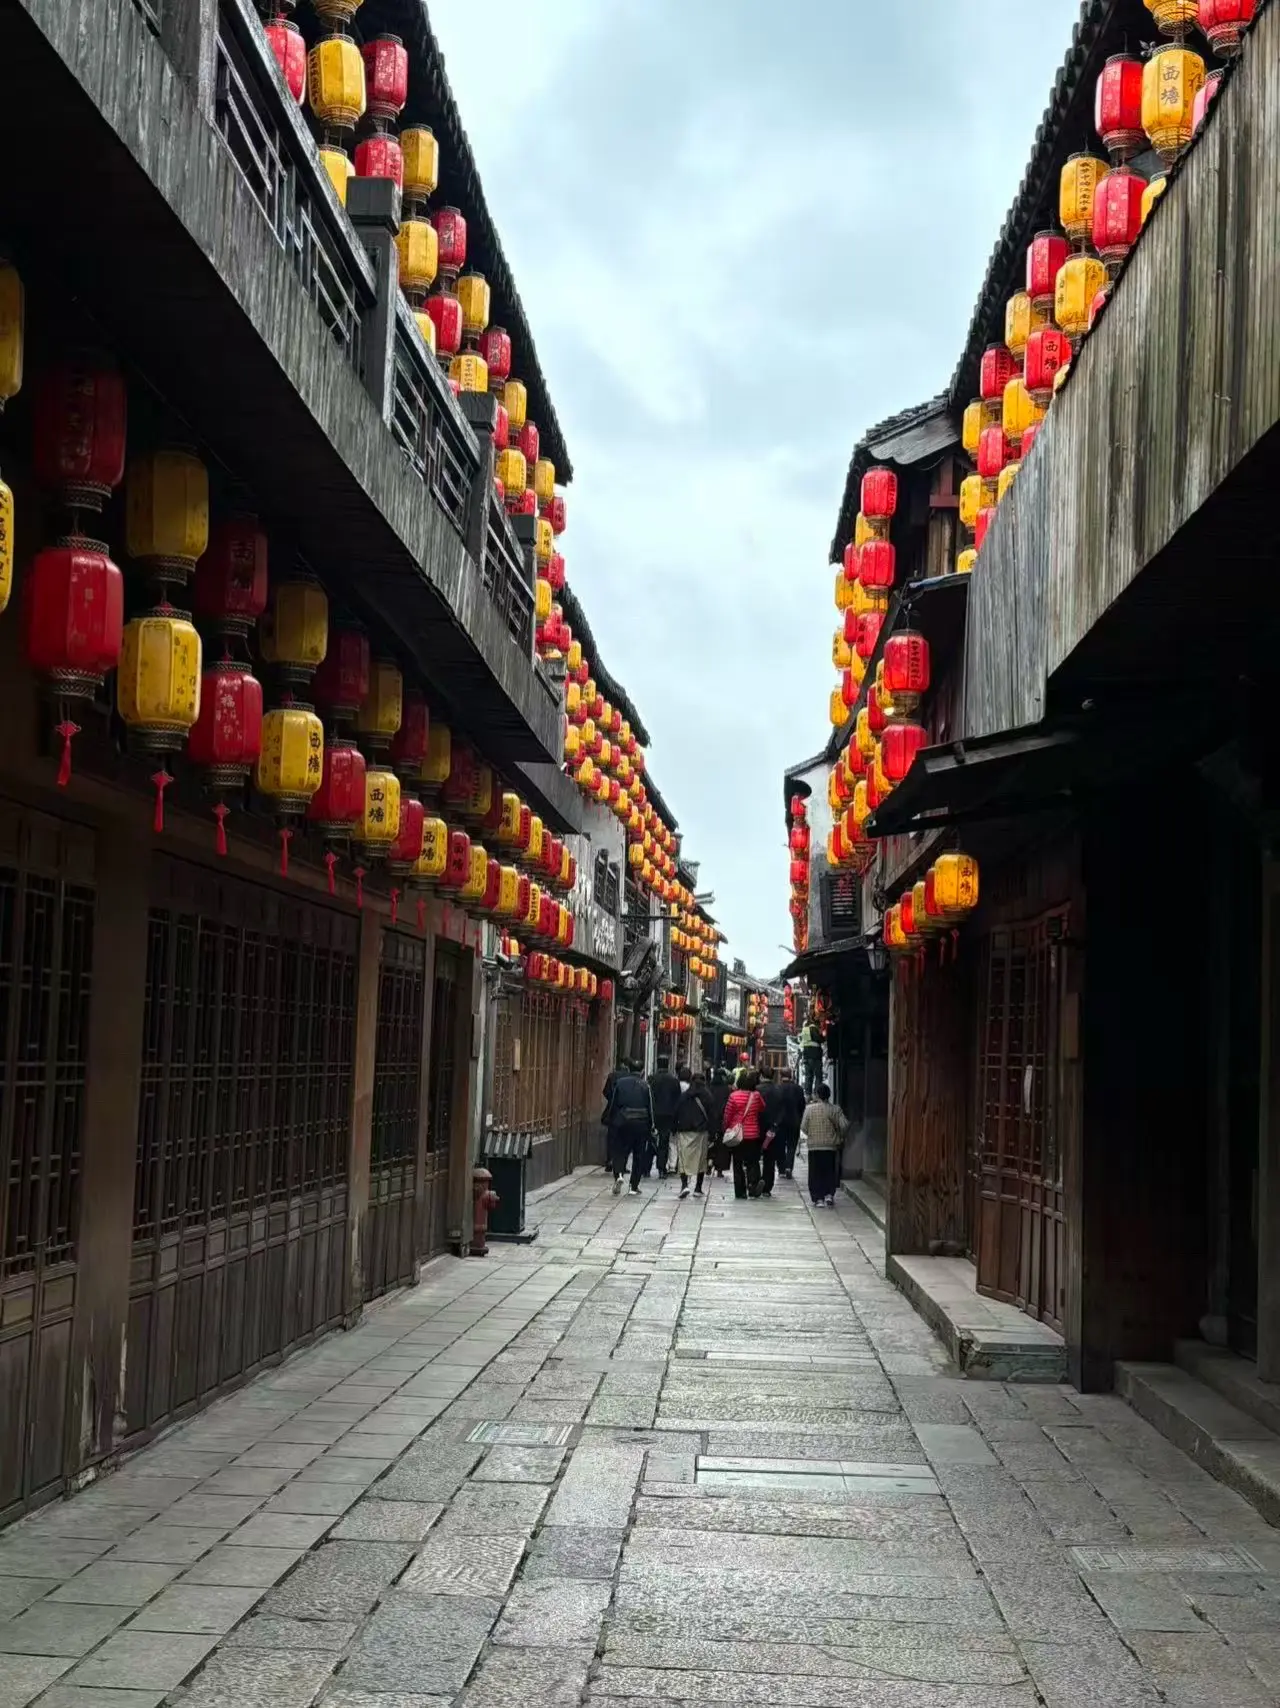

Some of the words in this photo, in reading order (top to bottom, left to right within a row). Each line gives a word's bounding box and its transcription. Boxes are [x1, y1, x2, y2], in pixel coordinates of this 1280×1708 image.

[1161, 66, 1180, 105] 西塘
[1045, 341, 1059, 370] 西塘
[308, 732, 321, 773] 西塘
[369, 788, 385, 823] 西塘
[421, 831, 435, 861] 西塘
[961, 866, 972, 894] 西塘
